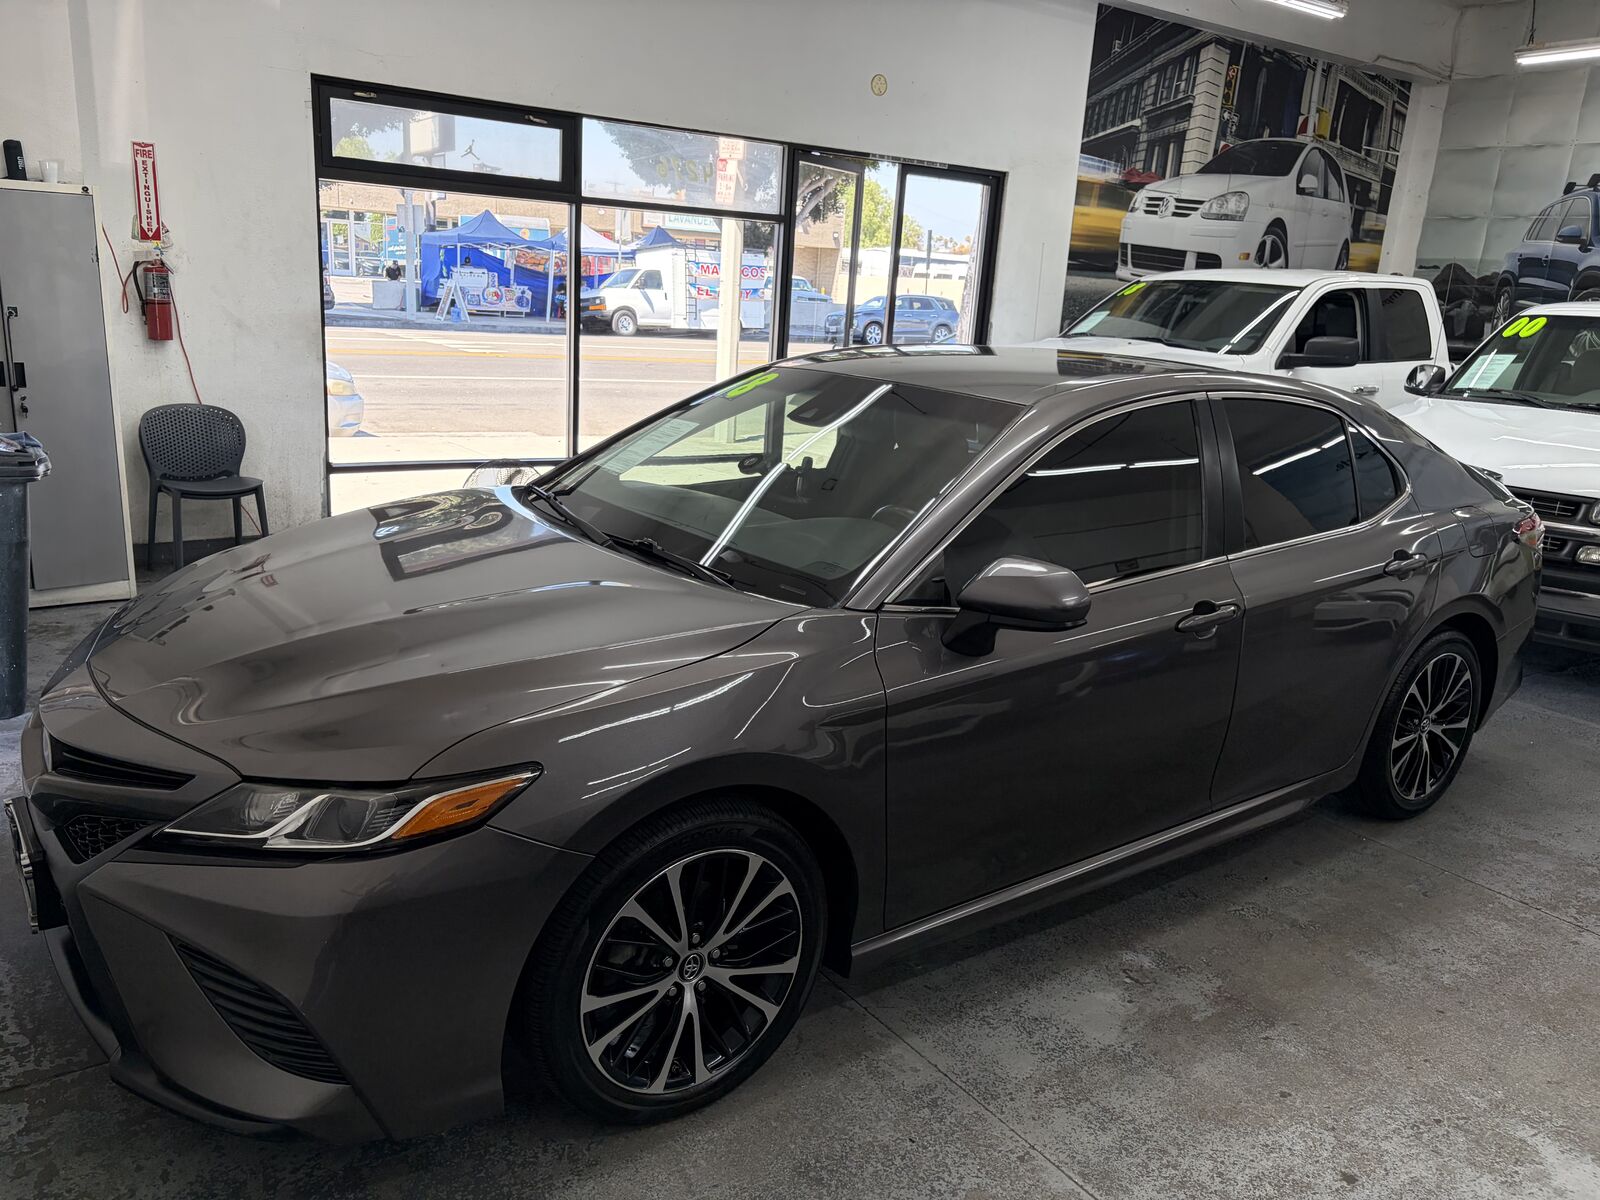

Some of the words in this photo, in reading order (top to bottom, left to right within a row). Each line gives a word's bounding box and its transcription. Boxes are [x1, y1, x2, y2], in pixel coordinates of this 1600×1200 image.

[135, 148, 153, 159] FIRE
[141, 159, 153, 233] EXTINGUISHER
[1502, 316, 1548, 338] 00
